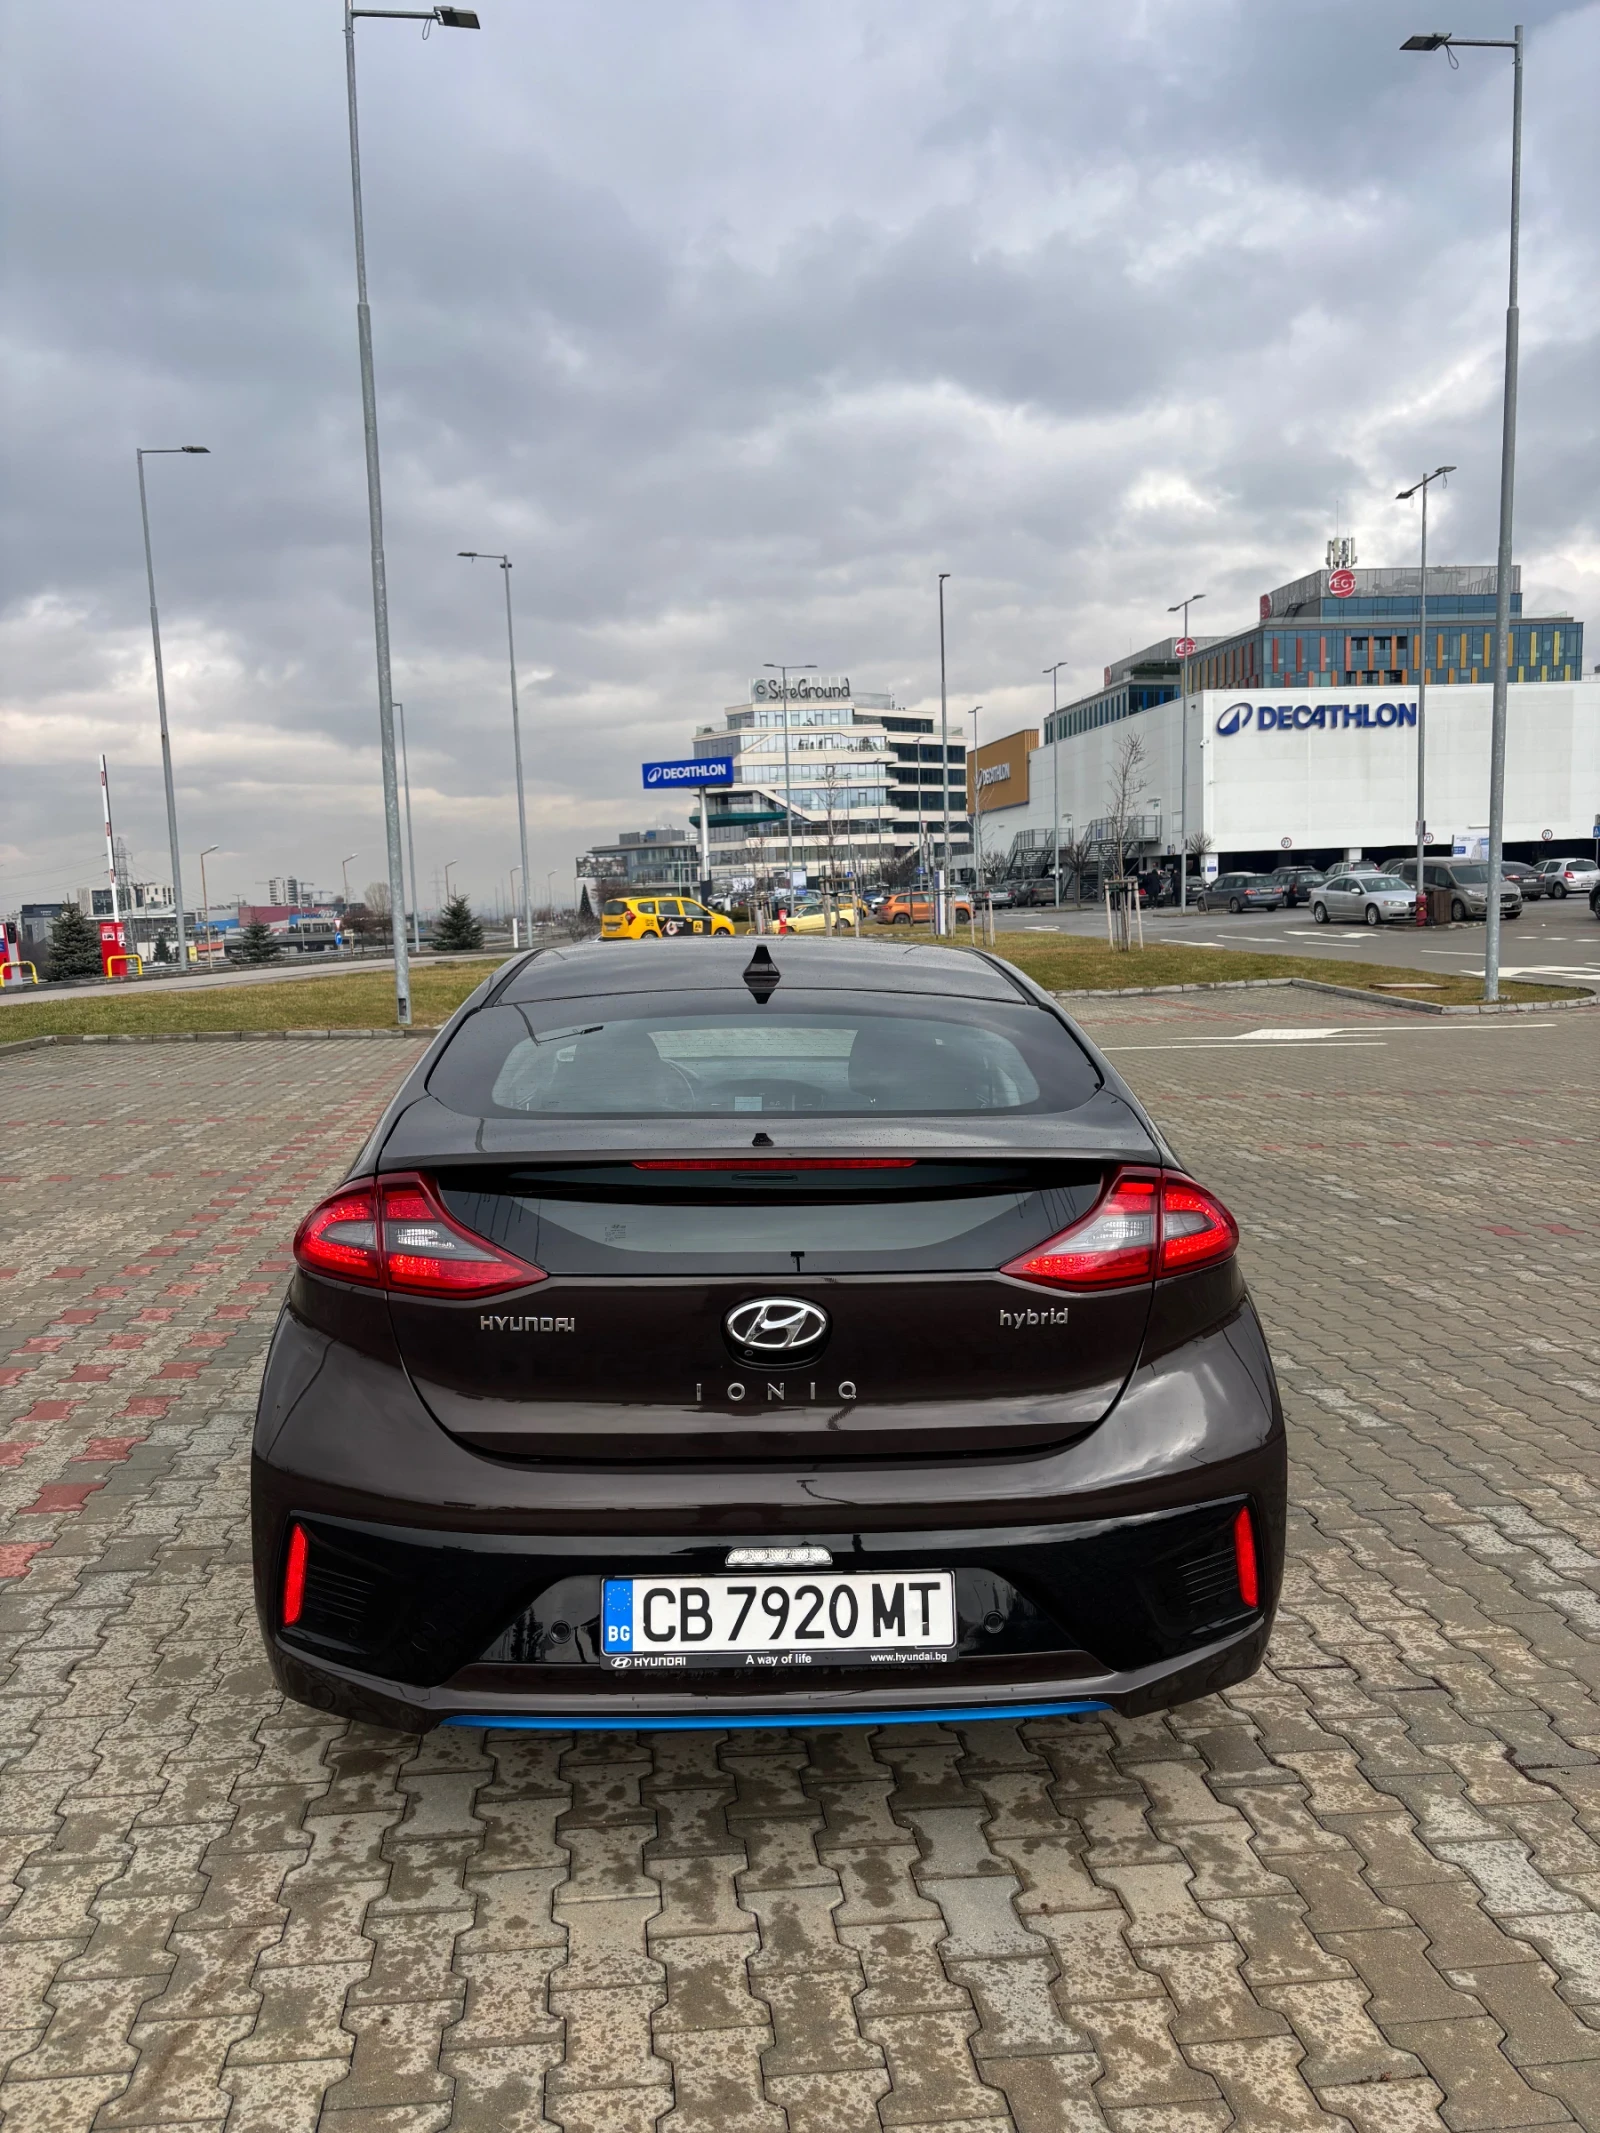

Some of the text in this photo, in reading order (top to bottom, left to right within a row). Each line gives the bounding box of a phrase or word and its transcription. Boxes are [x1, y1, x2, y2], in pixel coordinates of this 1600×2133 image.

[768, 678, 851, 699] SiteGround
[1257, 702, 1417, 731] DECATHLON
[663, 763, 726, 780] DECATHLON
[480, 1315, 575, 1332] HYUNDAI
[1000, 1307, 1069, 1330] hybrid
[696, 1381, 857, 1401] IONIQ
[643, 1582, 941, 1642] CB 7920 MT
[608, 1625, 631, 1642] BG
[634, 1657, 686, 1667] HYUNDAI
[745, 1653, 813, 1667] A way of life
[870, 1651, 948, 1663] www.hyundai.bg
